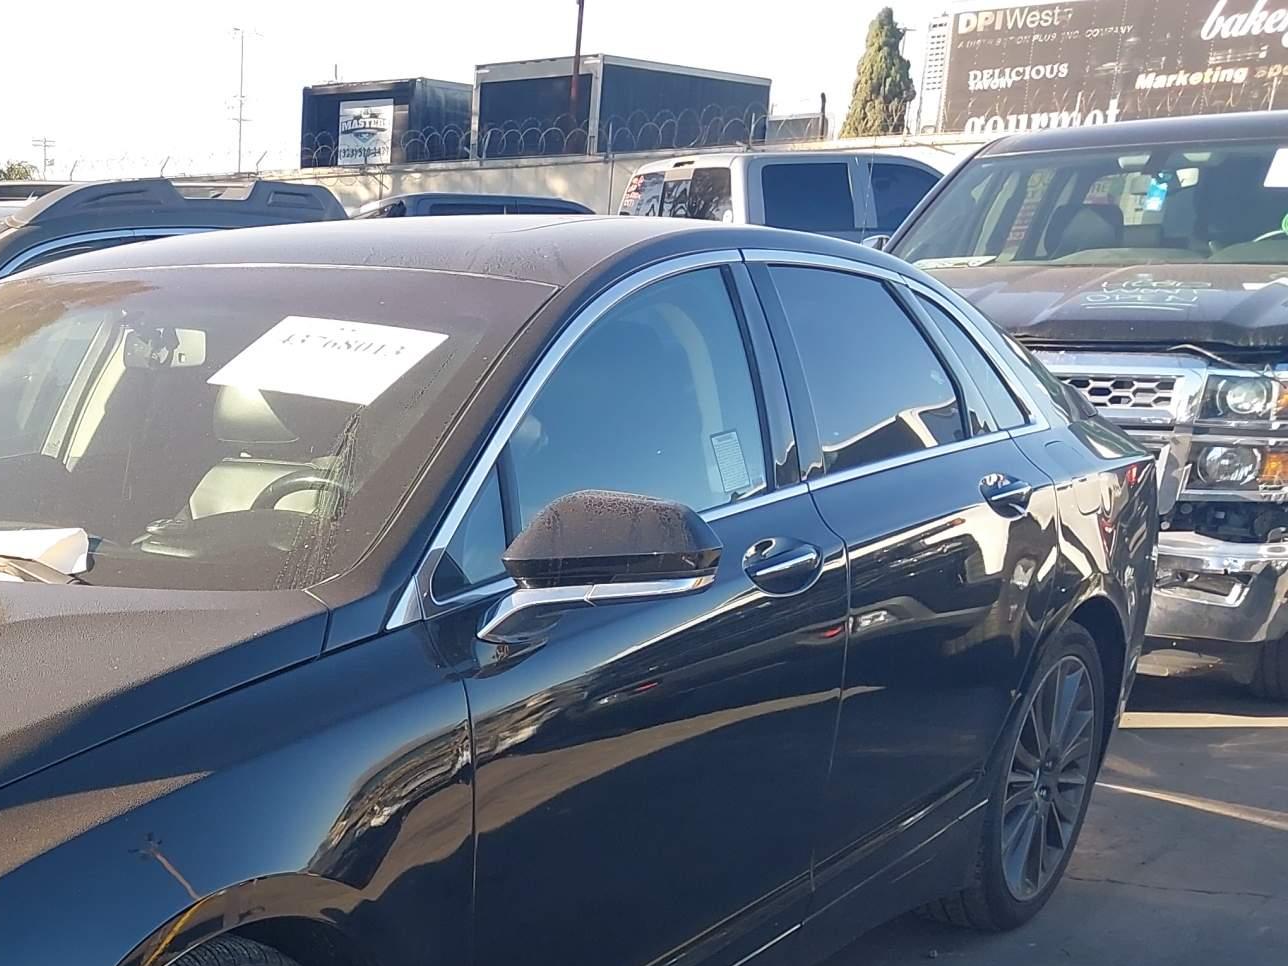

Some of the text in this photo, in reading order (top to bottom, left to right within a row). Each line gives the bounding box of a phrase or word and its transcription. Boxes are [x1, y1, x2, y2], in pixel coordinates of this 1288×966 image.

[958, 6, 1060, 34] DPIWest
[968, 63, 1069, 82] DELICIOUS
[1135, 66, 1249, 89] Marketing
